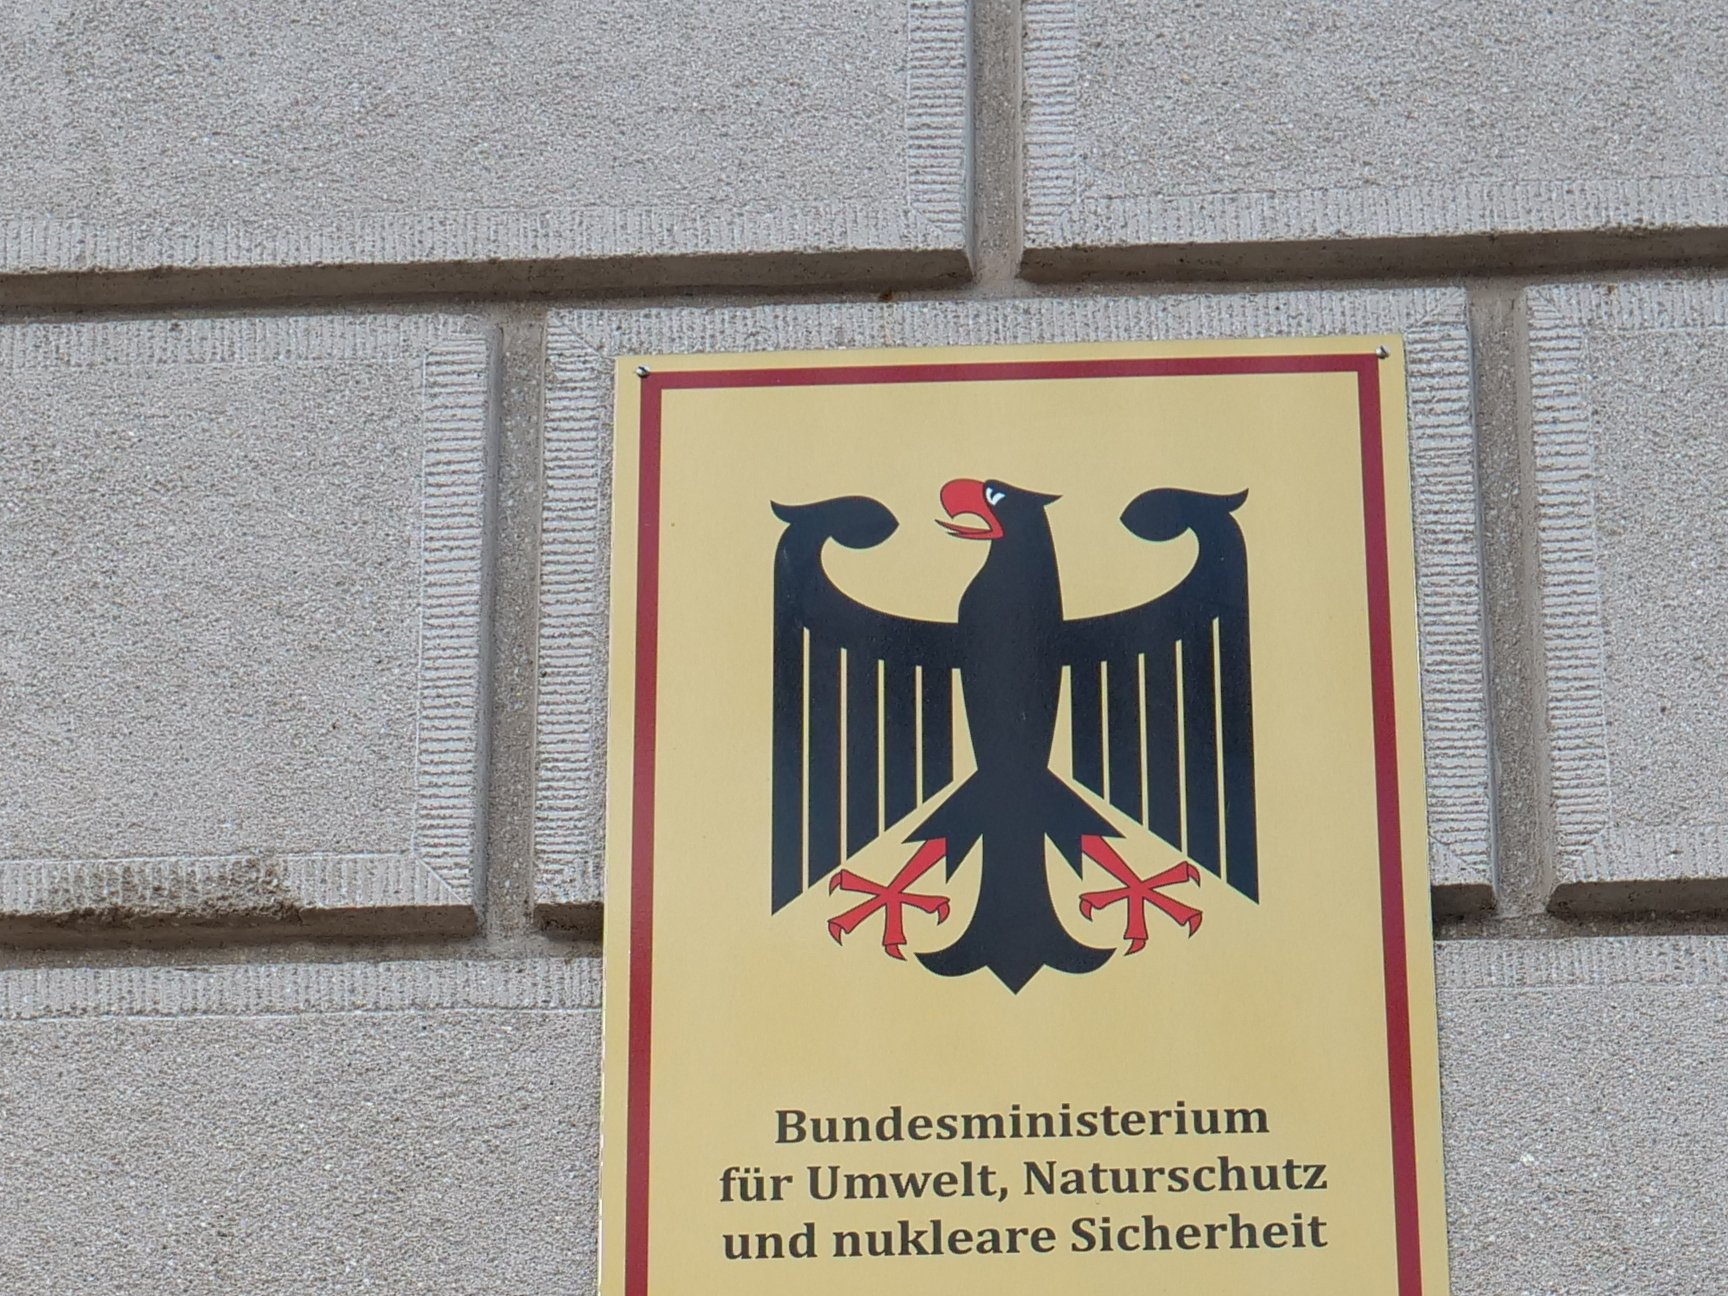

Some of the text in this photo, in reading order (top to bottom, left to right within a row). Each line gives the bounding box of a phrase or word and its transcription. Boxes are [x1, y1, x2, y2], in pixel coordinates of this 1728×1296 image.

[775, 1101, 1269, 1143] Bundesministerium
[720, 1156, 1328, 1202] für Umwelt, Naturschutz
[722, 1213, 1328, 1260] und nukleare Sicherheit
